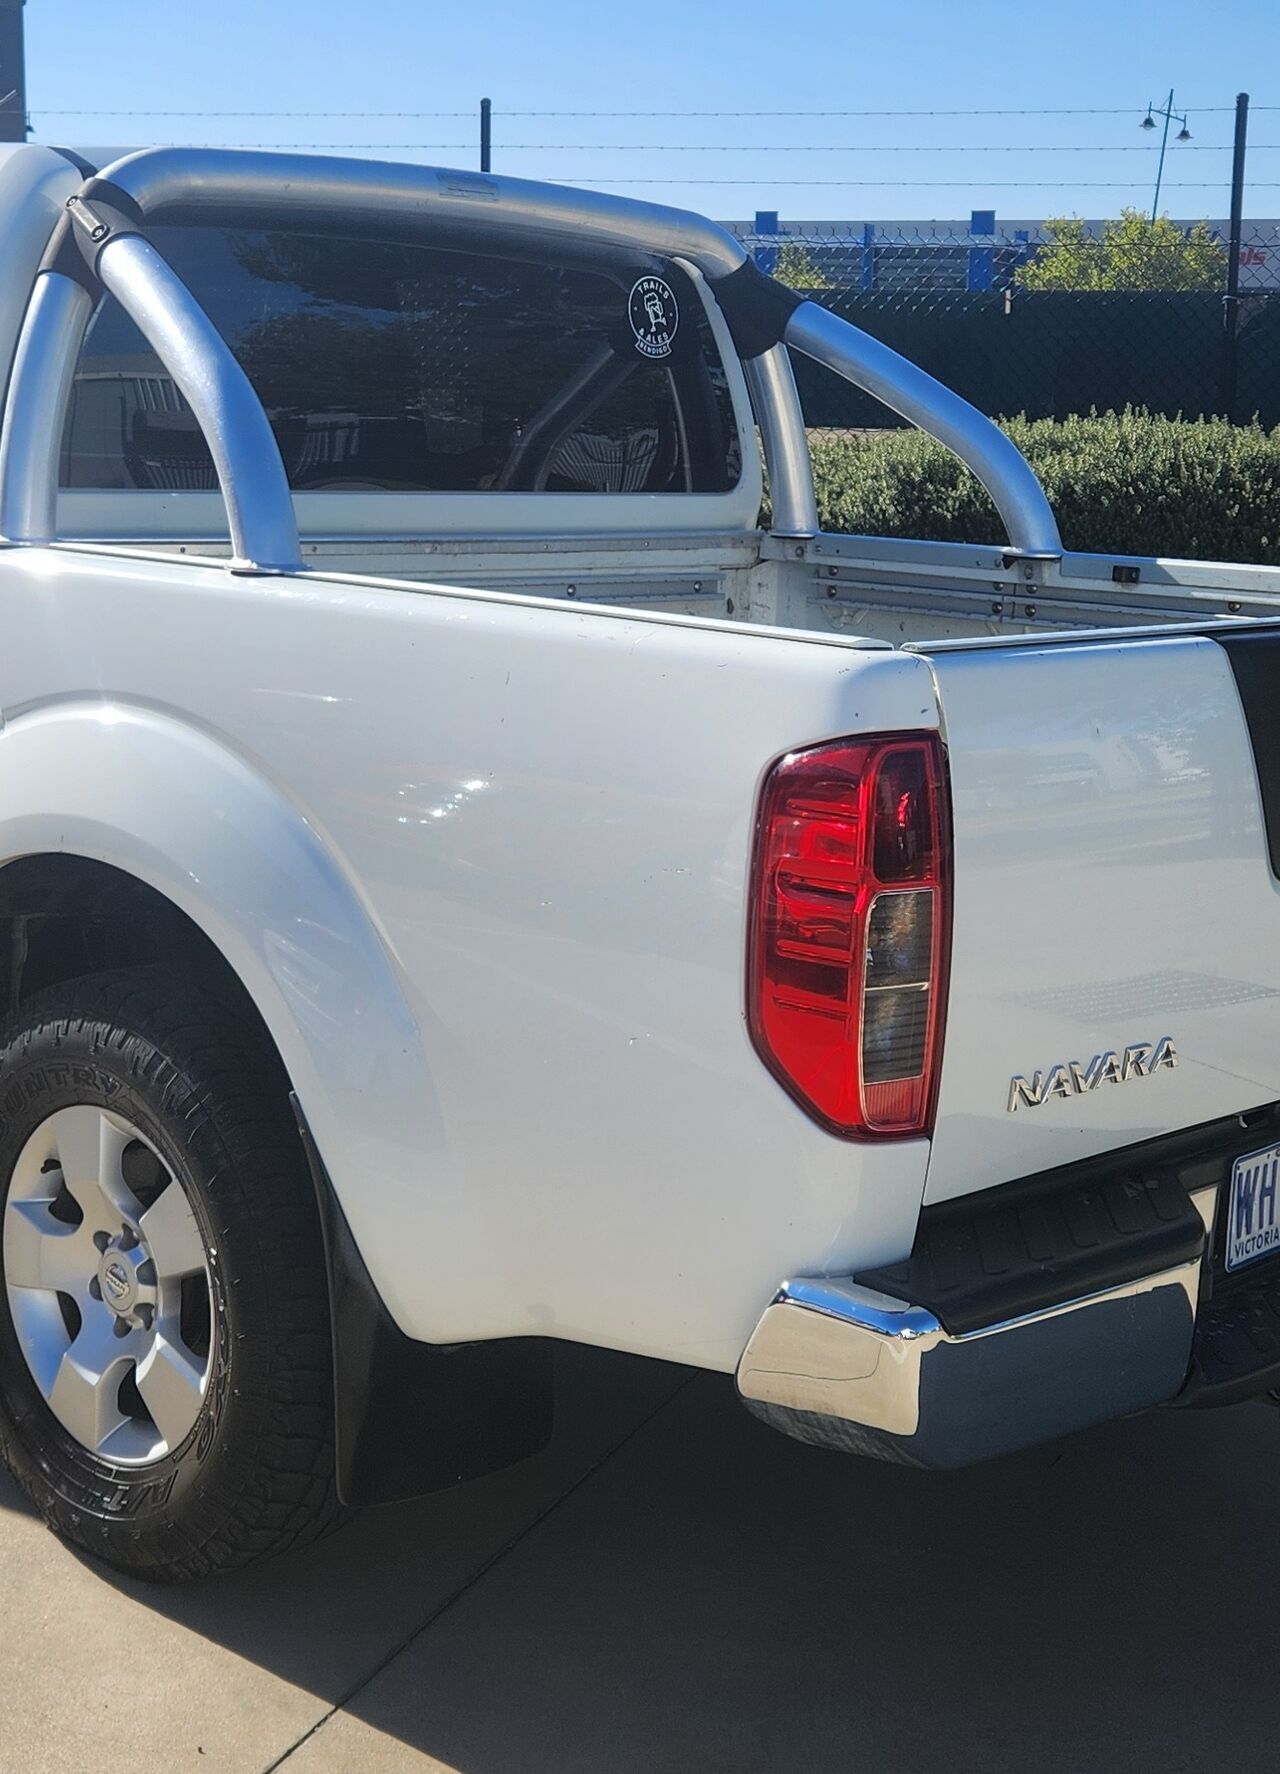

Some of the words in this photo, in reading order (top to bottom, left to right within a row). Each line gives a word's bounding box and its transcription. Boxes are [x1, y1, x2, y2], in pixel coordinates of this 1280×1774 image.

[638, 281, 670, 300] TRAILS
[646, 332, 669, 344] ALES
[1006, 1036, 1180, 1113] NAVARA
[1234, 1226, 1280, 1259] VICTORIA
